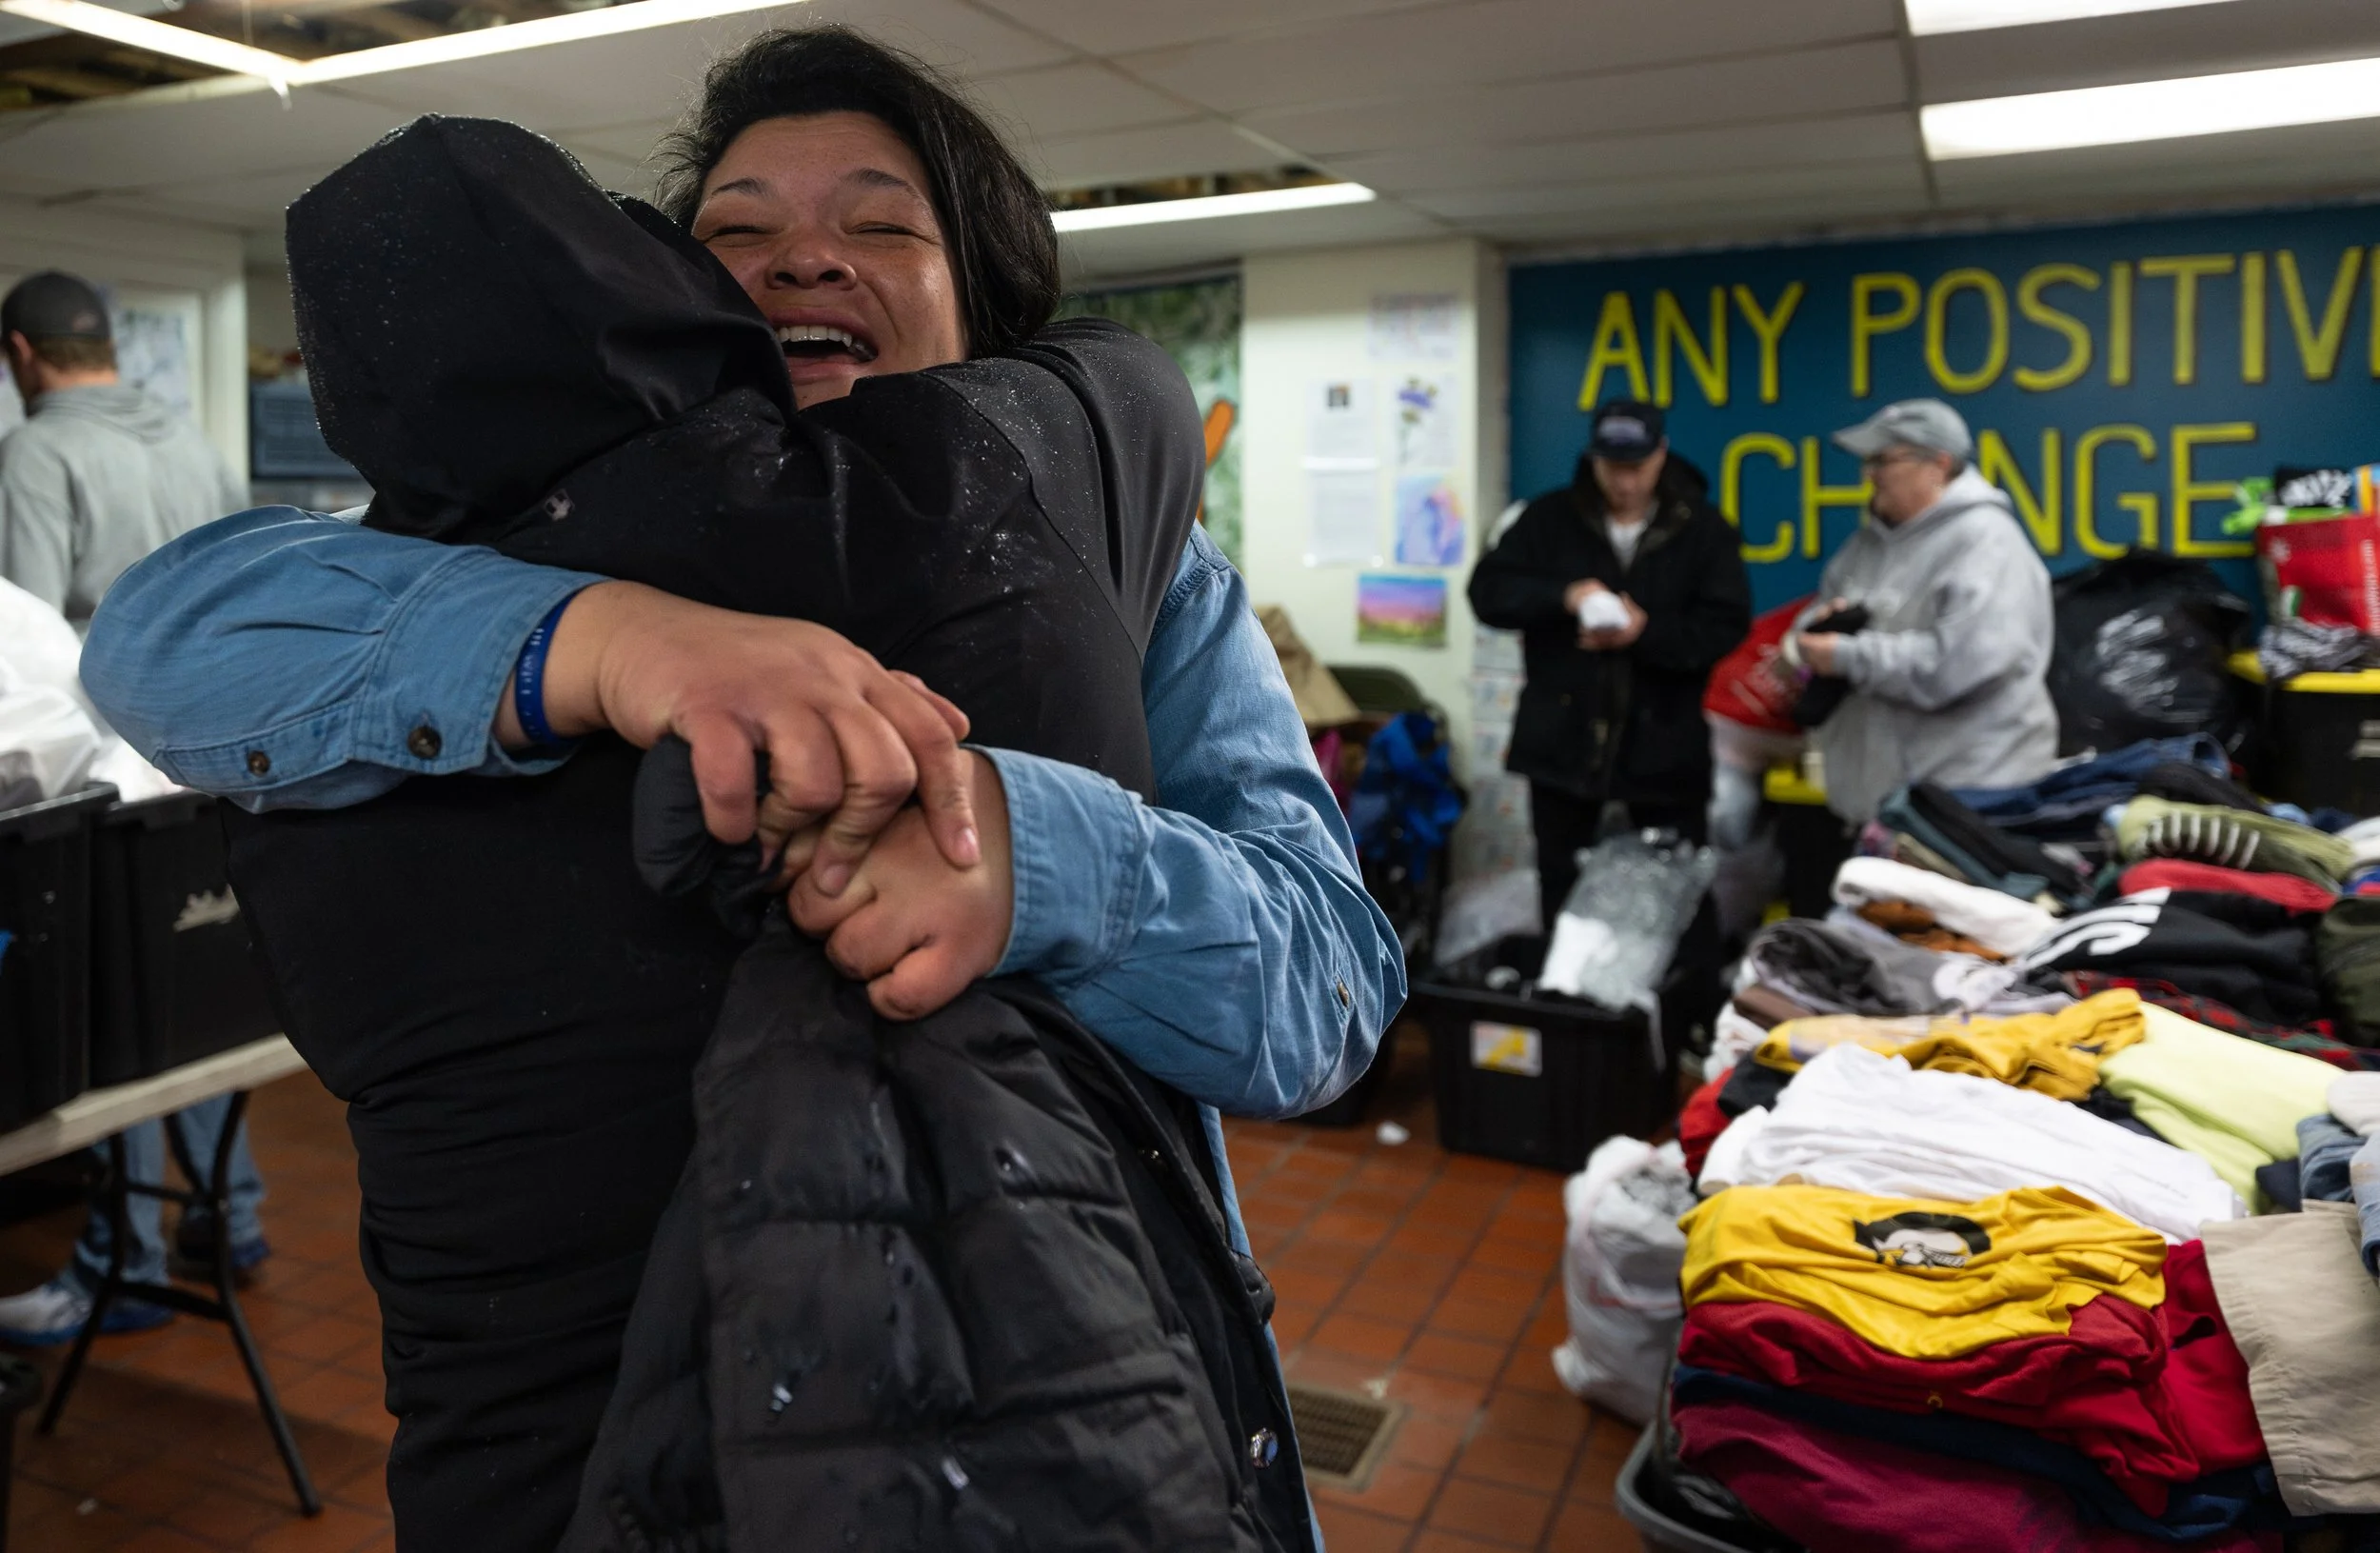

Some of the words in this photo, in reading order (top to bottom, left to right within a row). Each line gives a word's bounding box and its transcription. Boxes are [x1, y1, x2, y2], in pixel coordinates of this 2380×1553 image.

[1577, 283, 1803, 412] ANY
[1851, 246, 2380, 397] POSITIV
[1718, 422, 2256, 562] CHNGE
